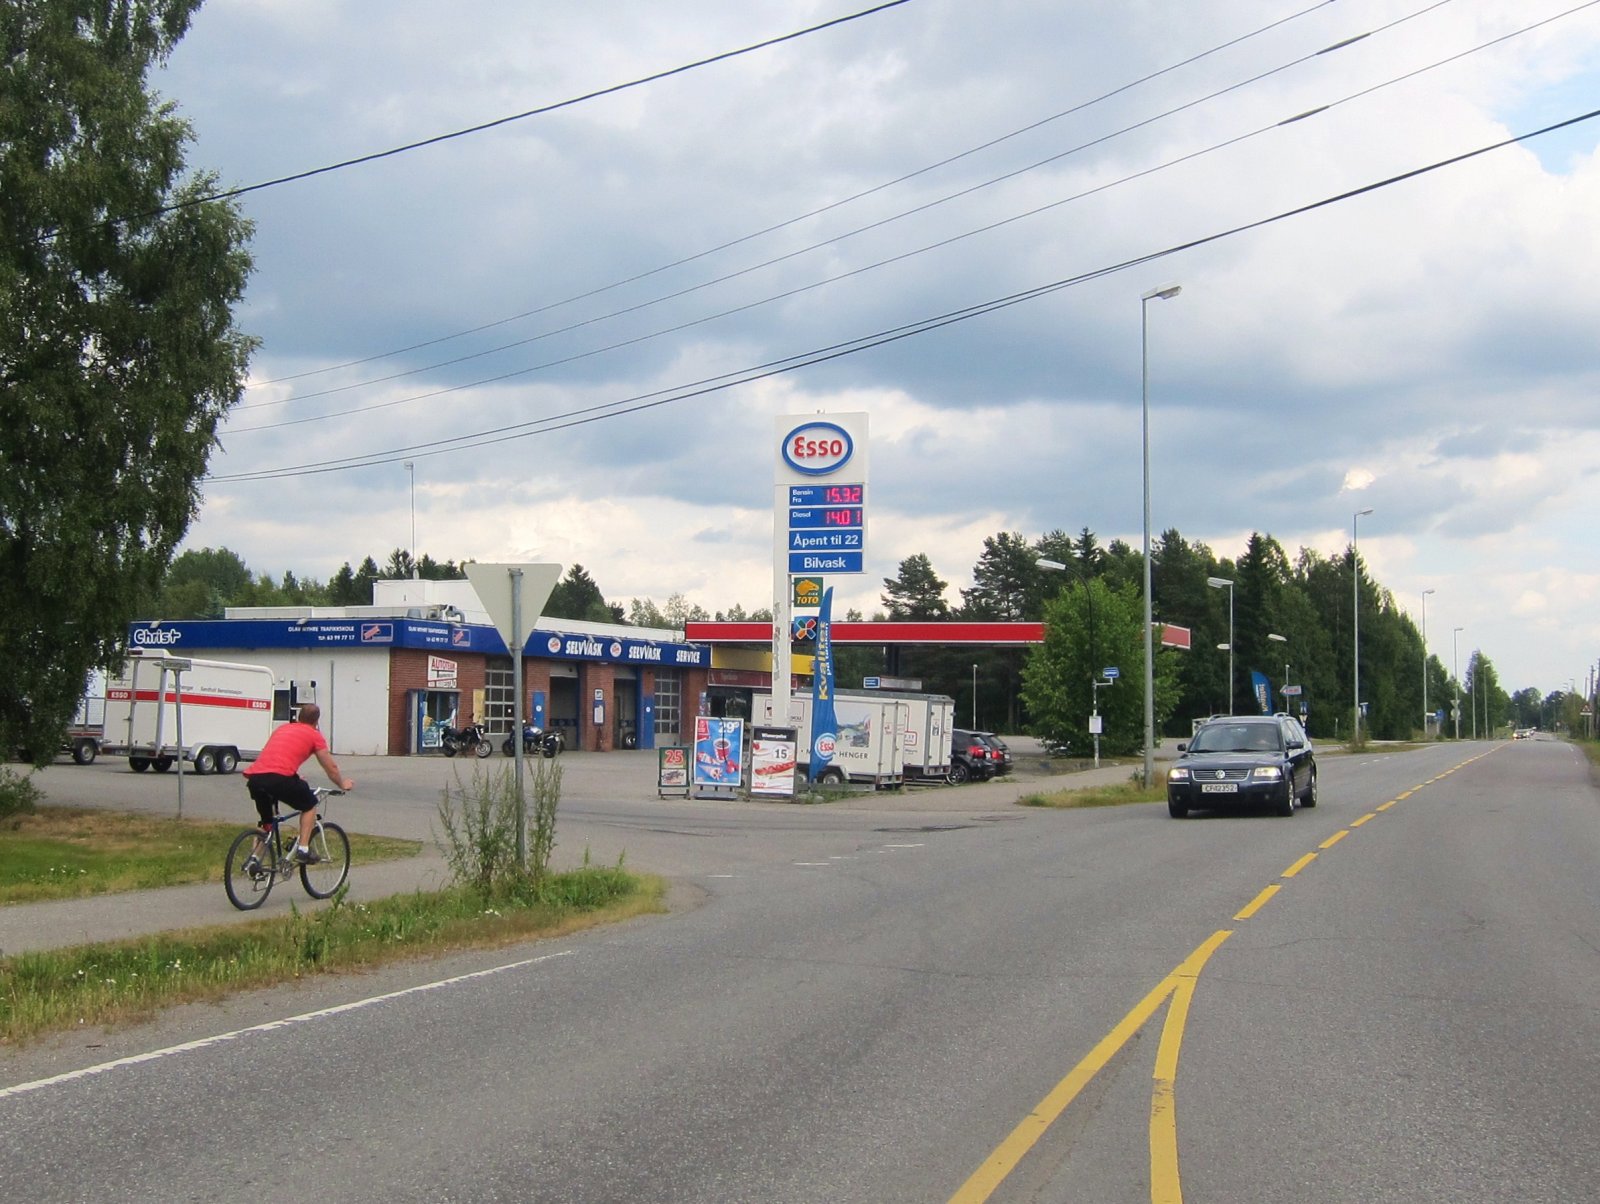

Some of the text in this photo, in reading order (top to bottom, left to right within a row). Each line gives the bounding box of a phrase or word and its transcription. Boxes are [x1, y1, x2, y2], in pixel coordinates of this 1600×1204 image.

[792, 488, 814, 496] Bensin
[792, 496, 802, 504] Fra
[793, 533, 859, 547] Åpent til 22
[803, 557, 846, 569] Bilvask
[796, 596, 819, 605] TOTO
[134, 629, 182, 645] Christ
[676, 650, 700, 663] SERVICE
[252, 701, 267, 709] ESSO
[665, 750, 683, 764] 25
[775, 750, 787, 759] 15
[839, 751, 868, 759] HENGER
